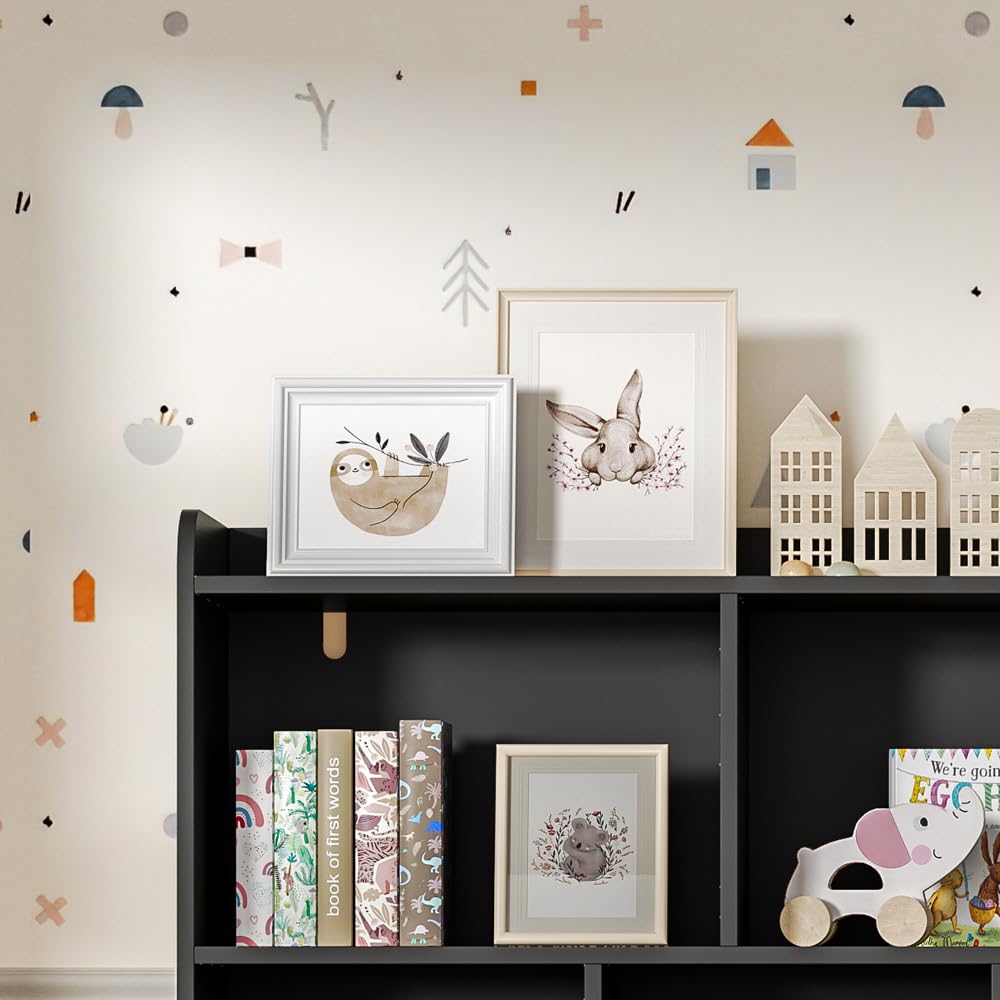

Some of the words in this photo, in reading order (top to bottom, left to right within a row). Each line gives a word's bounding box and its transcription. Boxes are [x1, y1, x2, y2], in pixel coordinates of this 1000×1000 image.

[326, 756, 340, 810] words
[931, 760, 967, 775] We're
[326, 814, 340, 846] first
[326, 851, 340, 869] of
[326, 874, 340, 917] book
